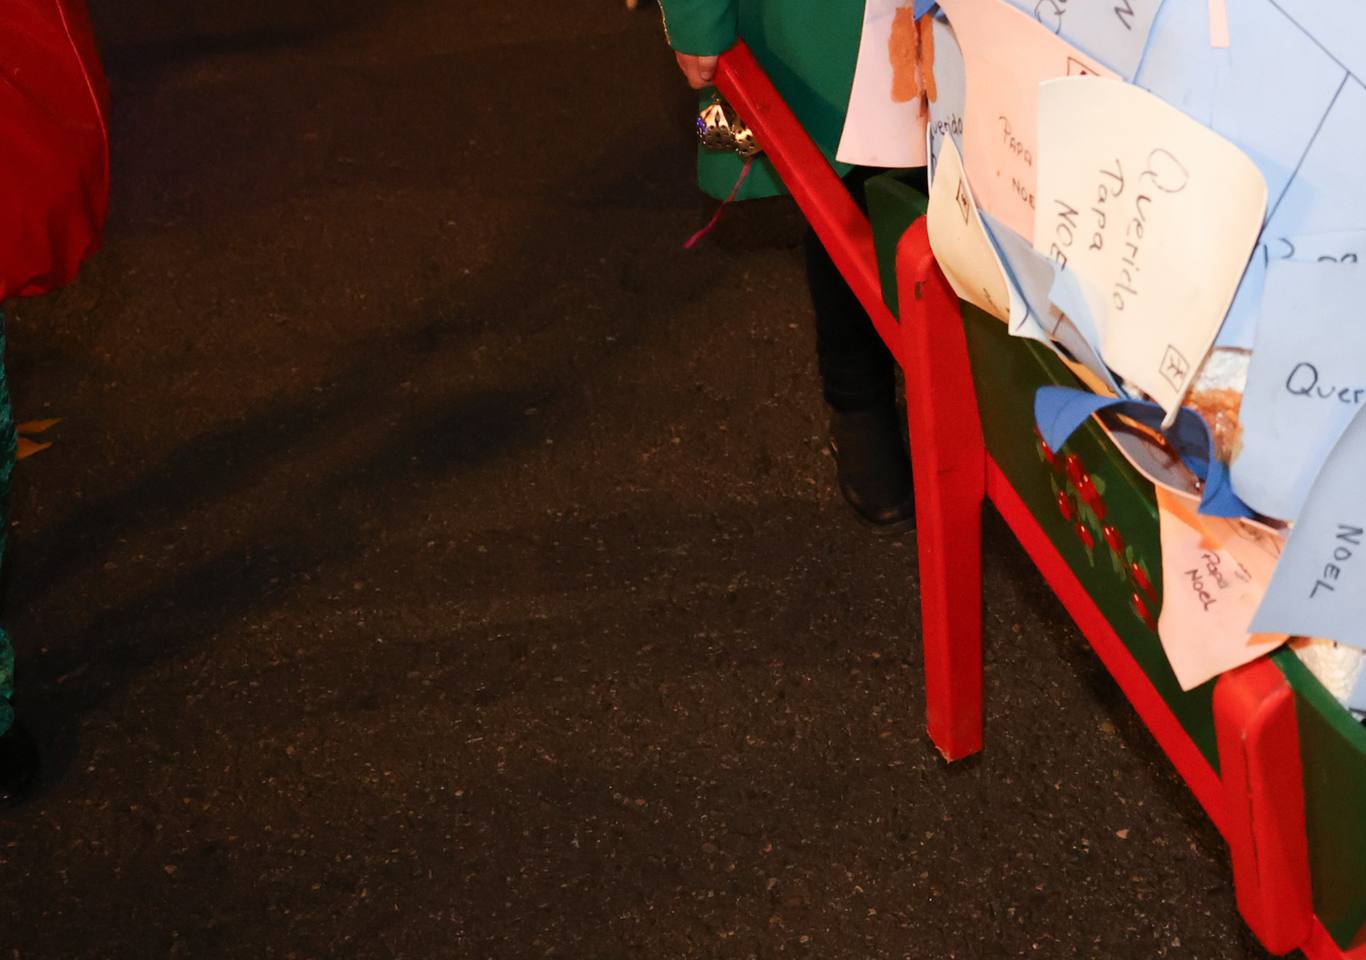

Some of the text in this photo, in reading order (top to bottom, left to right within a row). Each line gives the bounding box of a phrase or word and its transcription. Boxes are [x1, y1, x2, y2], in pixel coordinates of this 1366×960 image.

[1089, 158, 1124, 251] Papa
[1113, 148, 1189, 311] Querido
[1309, 523, 1364, 599] NOEL
